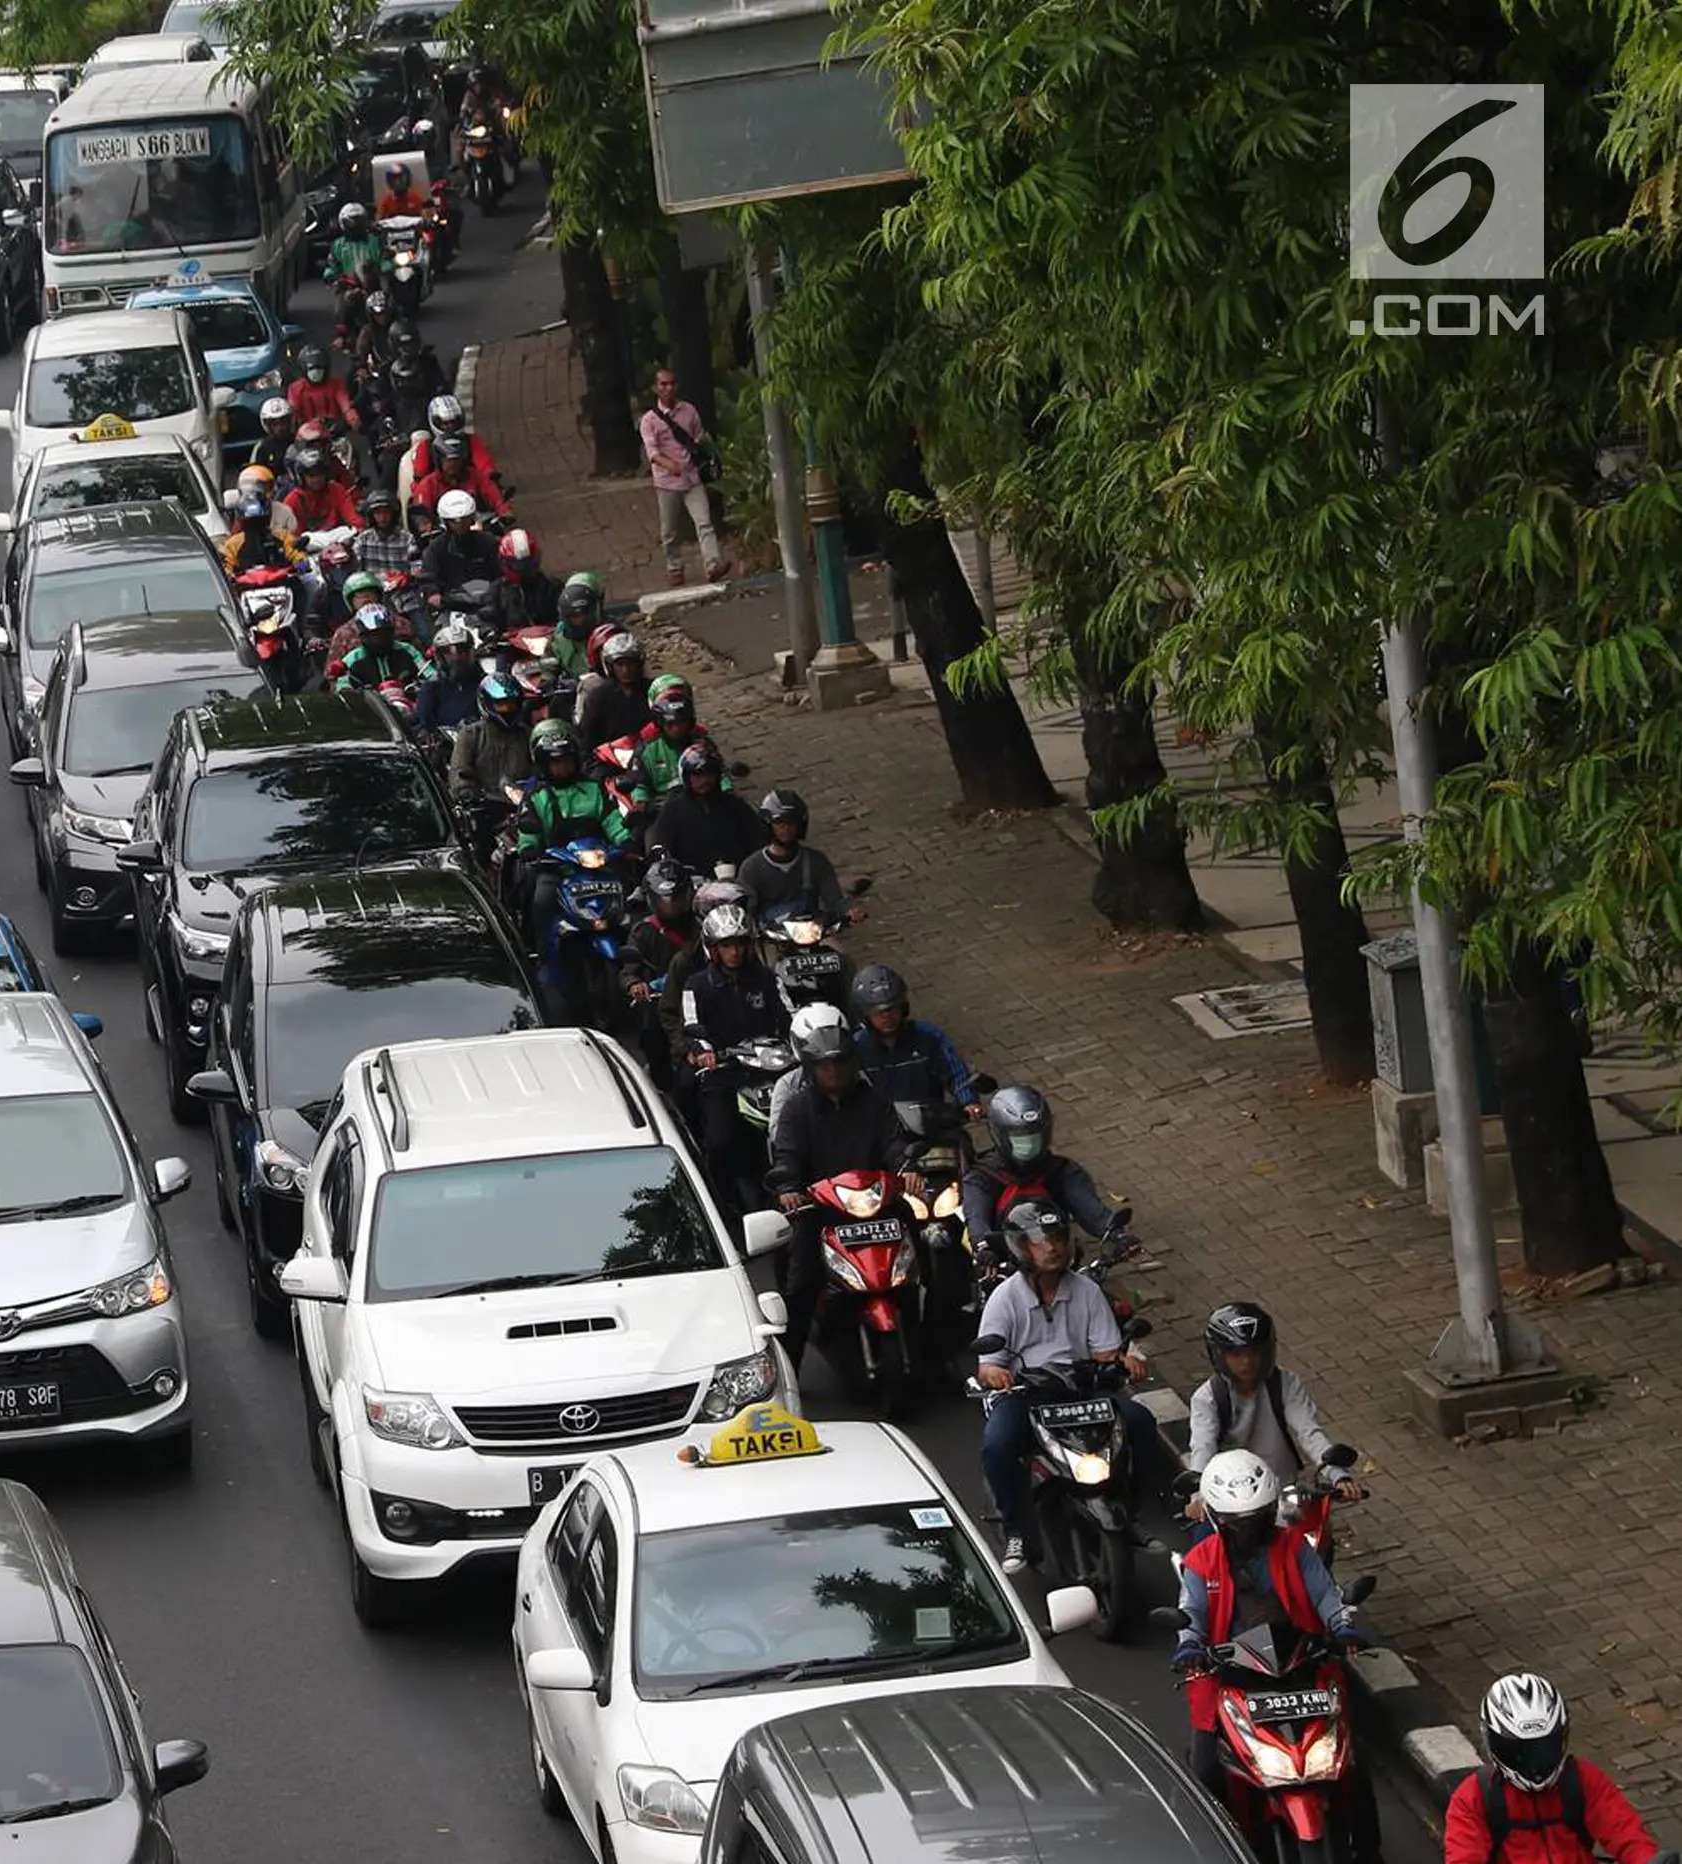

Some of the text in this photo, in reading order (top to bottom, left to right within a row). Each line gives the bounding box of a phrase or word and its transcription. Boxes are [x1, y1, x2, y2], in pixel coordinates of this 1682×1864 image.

[90, 426, 127, 439] TAKSI
[750, 1408, 795, 1432] E
[729, 1430, 803, 1457] TAKSI
[532, 1472, 542, 1492] B
[1248, 1693, 1327, 1712] B 3033 KNU
